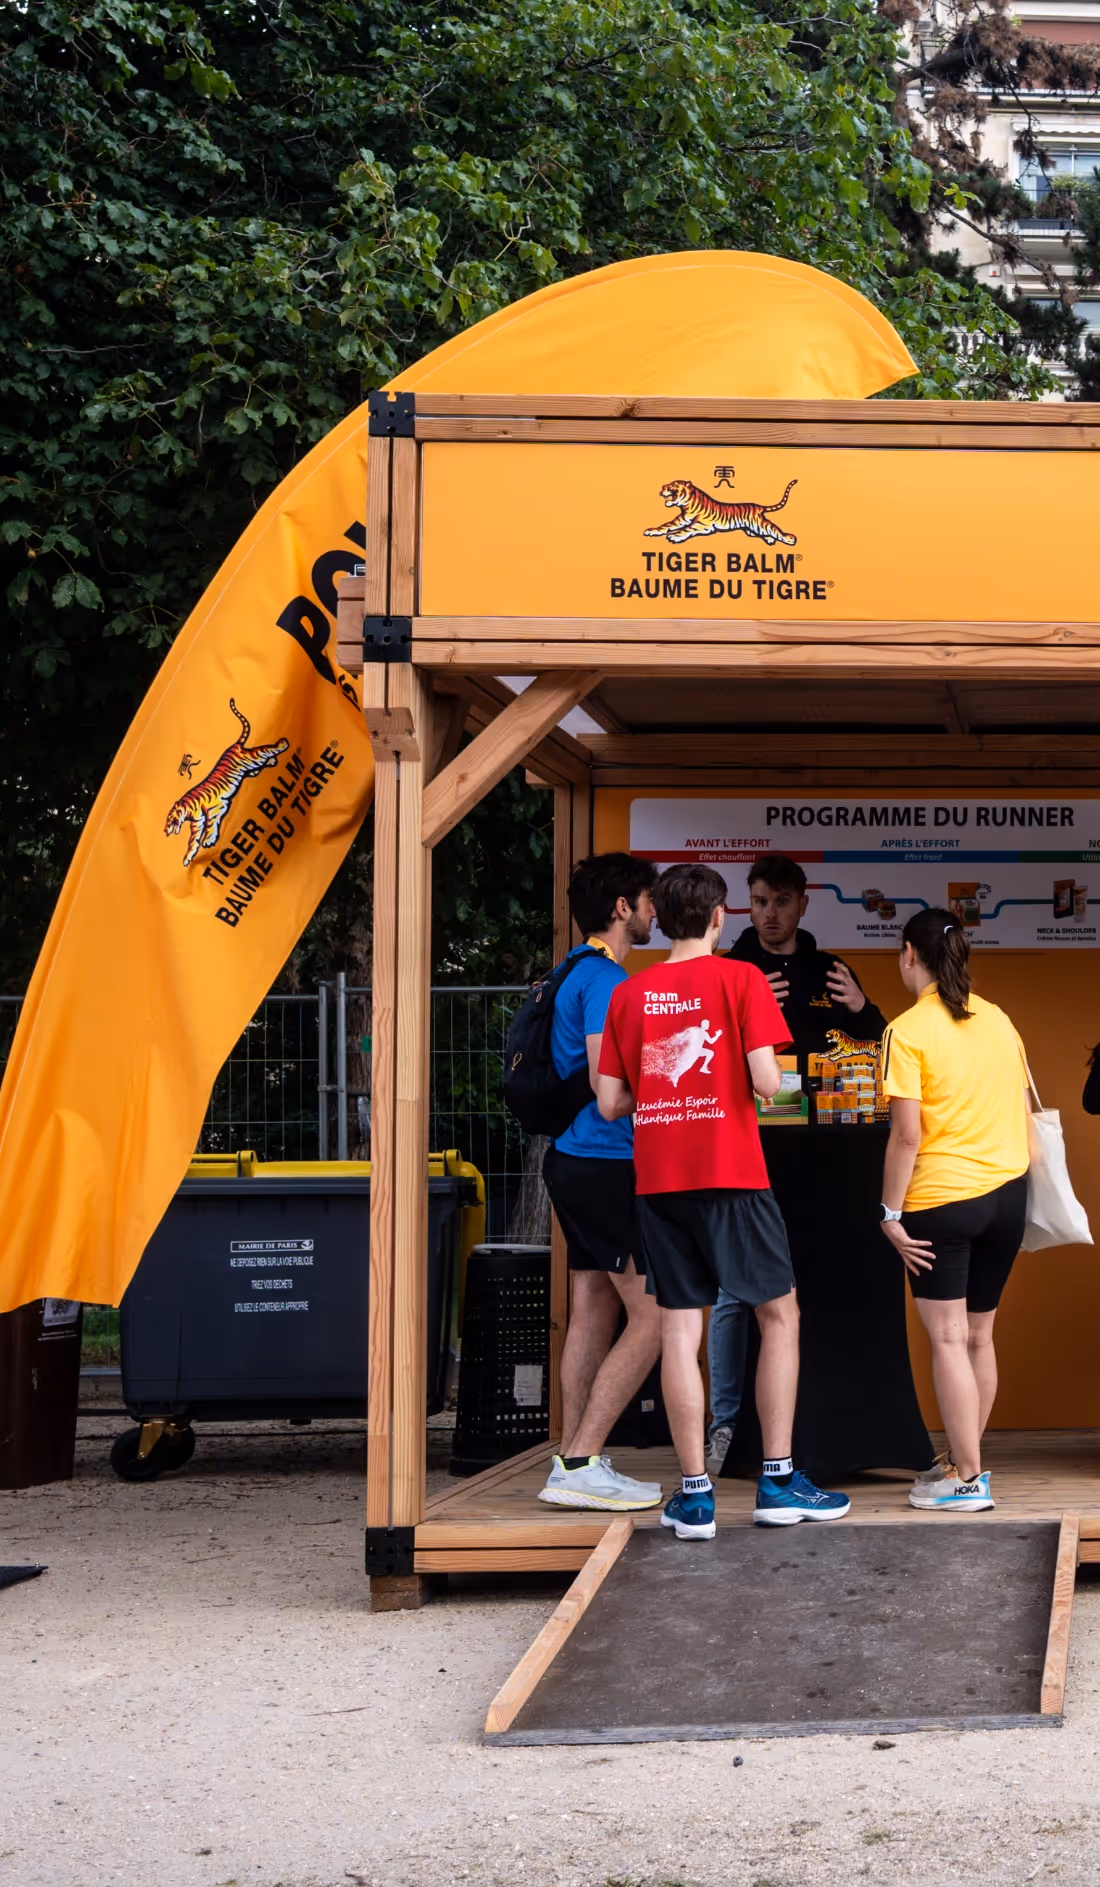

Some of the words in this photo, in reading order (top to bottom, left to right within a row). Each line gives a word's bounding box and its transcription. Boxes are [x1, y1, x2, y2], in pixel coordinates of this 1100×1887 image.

[642, 552, 716, 572] TIGER
[611, 578, 698, 598] BAUME
[709, 579, 742, 599] DU
[766, 806, 926, 827] PROGRAMME
[934, 806, 968, 827] DU
[976, 806, 1074, 827] RUNNER
[685, 838, 720, 848] AVANT
[723, 838, 771, 848] L'EFFORT
[881, 838, 913, 848] APRÈS
[916, 839, 960, 848] L'EFFORT
[202, 819, 265, 885] TIGER
[699, 853, 717, 861] Effet
[718, 853, 756, 861] chauffant
[904, 853, 922, 861] Effet
[923, 853, 943, 861] froid
[215, 852, 273, 928] BAUME
[266, 816, 295, 855] DU
[644, 991, 678, 1002] Team
[644, 998, 701, 1015] CENTRALE
[636, 1096, 683, 1112] Leucémie
[686, 1094, 719, 1107] Espoir
[687, 1108, 726, 1120] Famille
[230, 1258, 236, 1267] NE
[237, 1257, 256, 1267] DEPOSEZ
[257, 1257, 267, 1267] RIEN
[267, 1257, 276, 1267] SUR
[277, 1257, 282, 1266] LA
[282, 1256, 293, 1266] VOIE
[293, 1256, 313, 1266] PUBLIQUE
[251, 1279, 264, 1289] TRIEZ
[264, 1279, 273, 1289] VOS
[273, 1279, 293, 1289] DECHETS
[234, 1302, 253, 1312] UTILISEZ
[253, 1302, 259, 1312] LE
[685, 1478, 709, 1489] PUMA
[954, 1484, 980, 1496] HOKA
